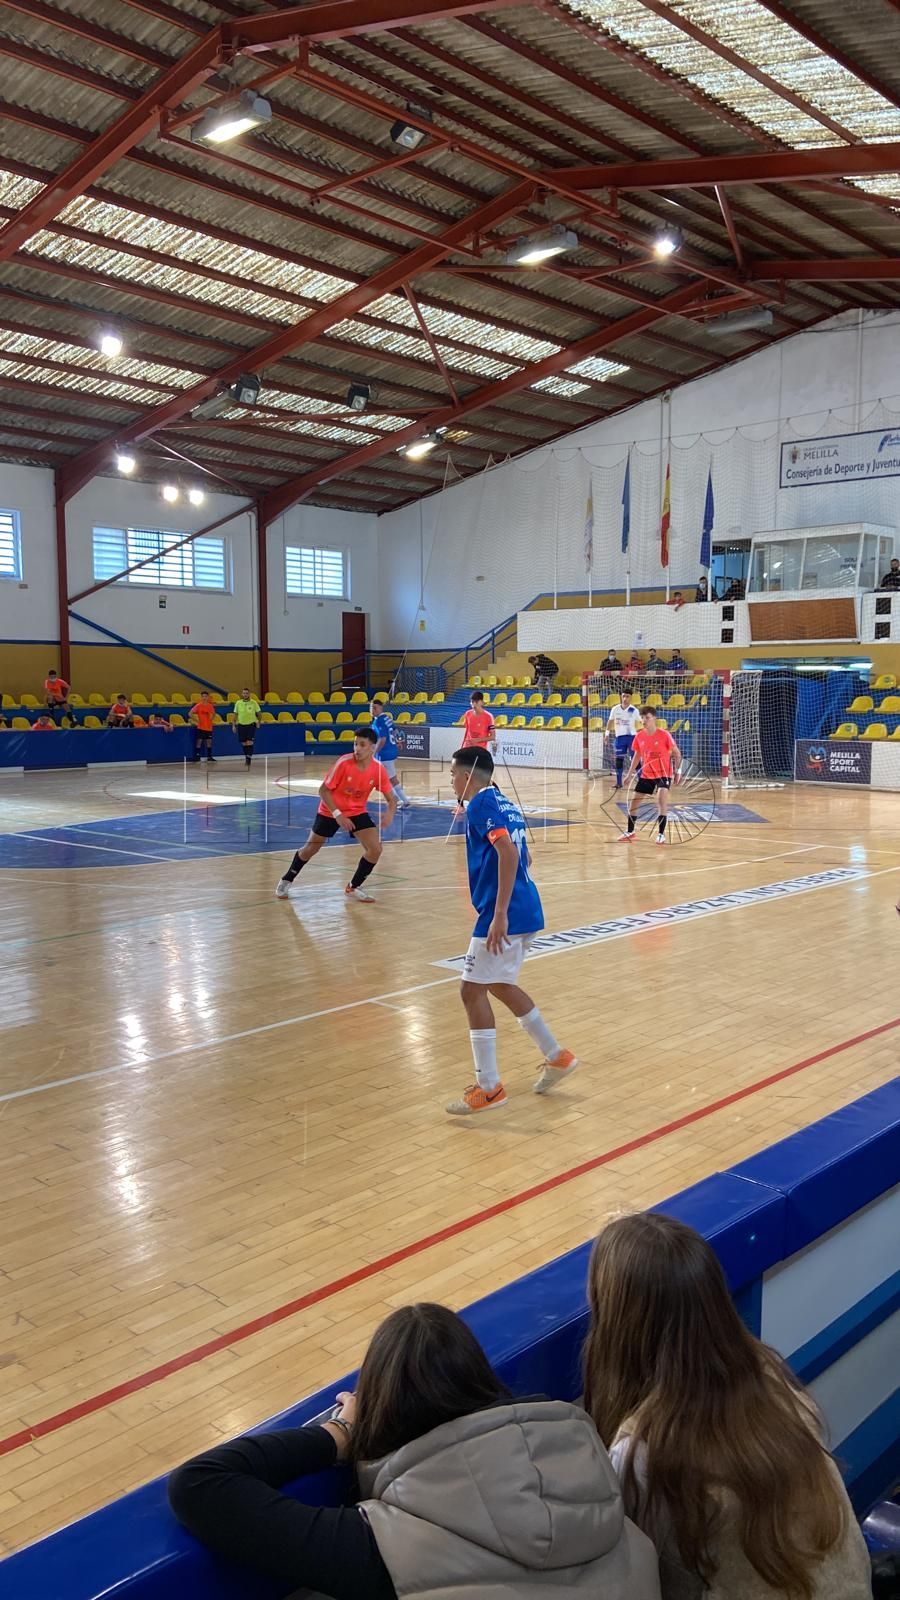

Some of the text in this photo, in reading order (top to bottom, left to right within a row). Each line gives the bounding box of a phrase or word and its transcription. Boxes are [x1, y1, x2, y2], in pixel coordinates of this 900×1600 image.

[803, 449, 839, 460] MELILLA
[824, 464, 833, 475] de
[834, 462, 865, 476] Deporte
[865, 462, 872, 474] y
[502, 746, 535, 757] MELILLA
